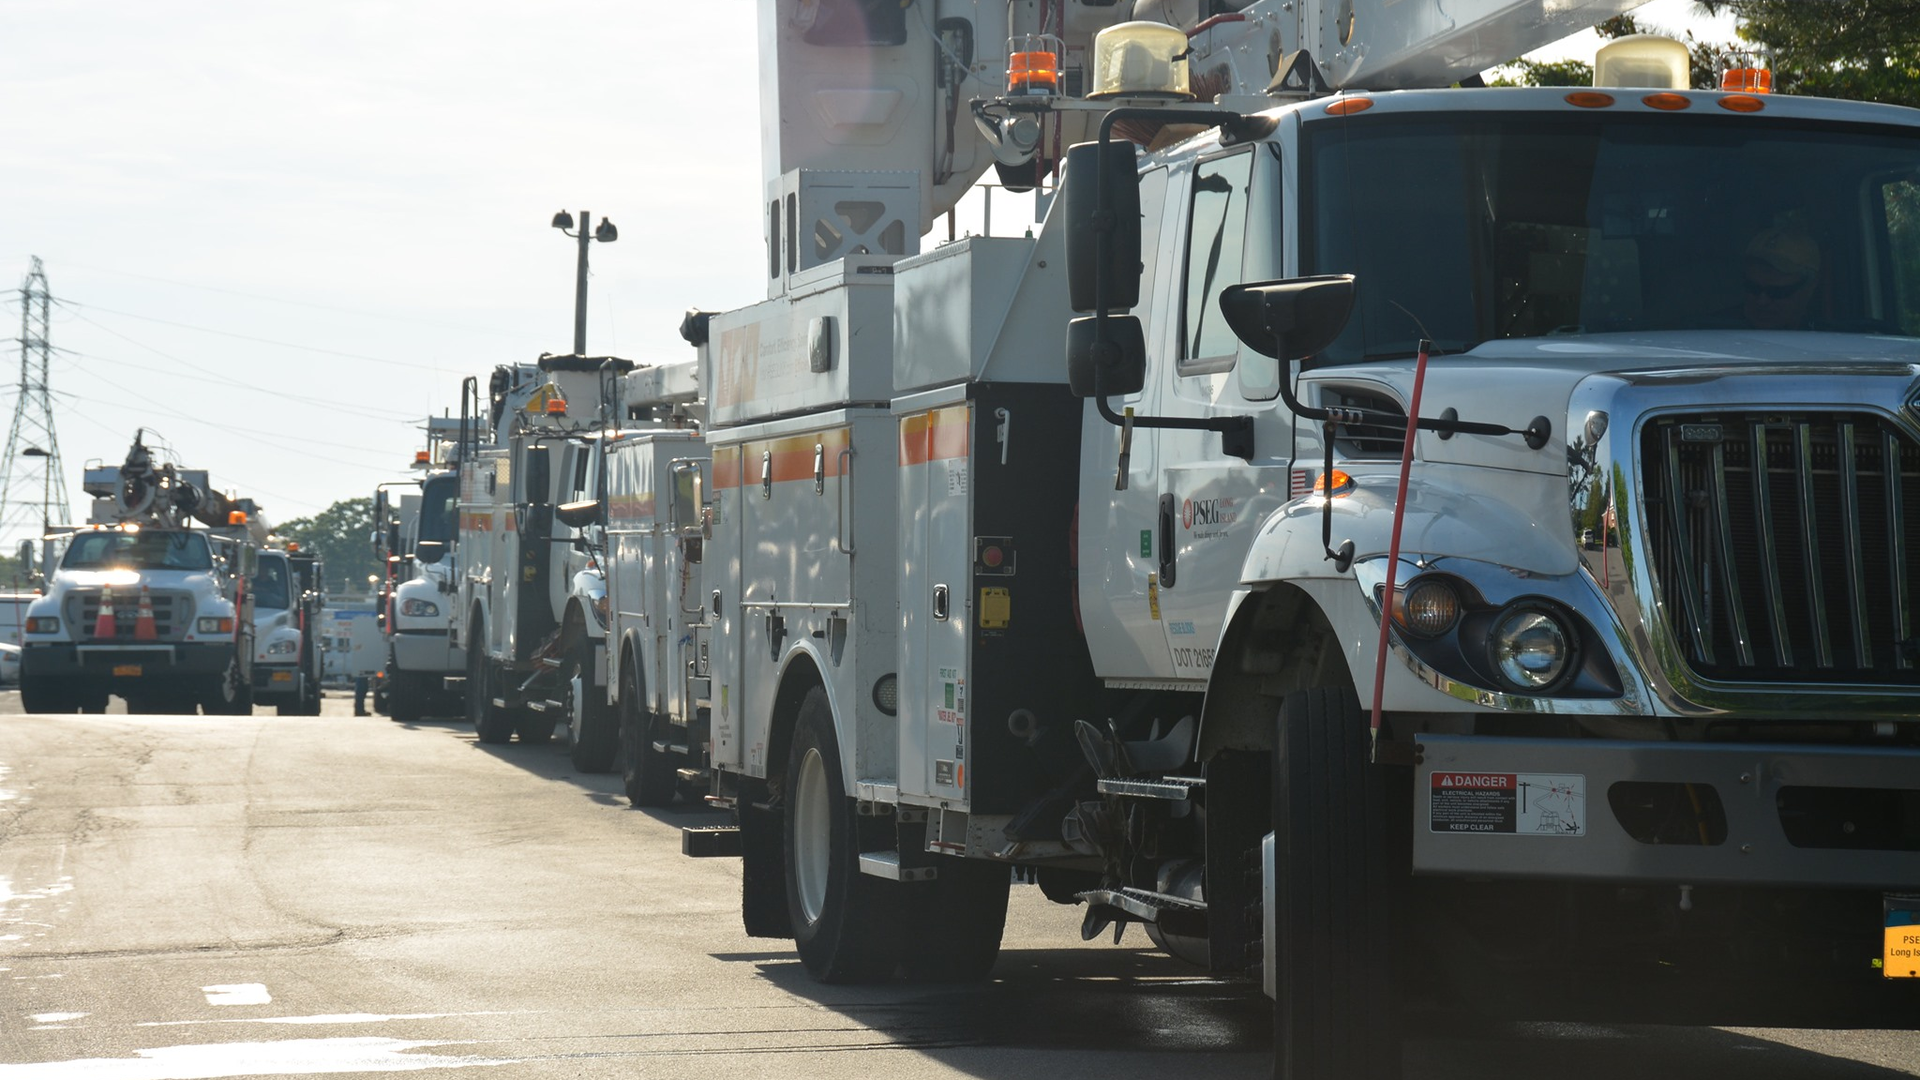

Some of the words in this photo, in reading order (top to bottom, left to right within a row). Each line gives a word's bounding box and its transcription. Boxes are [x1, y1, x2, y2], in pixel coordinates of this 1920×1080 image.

[1193, 498, 1219, 525] PSEG
[1174, 648, 1193, 668] DOT
[1455, 776, 1507, 787] DANGER
[1891, 948, 1911, 957] Long
